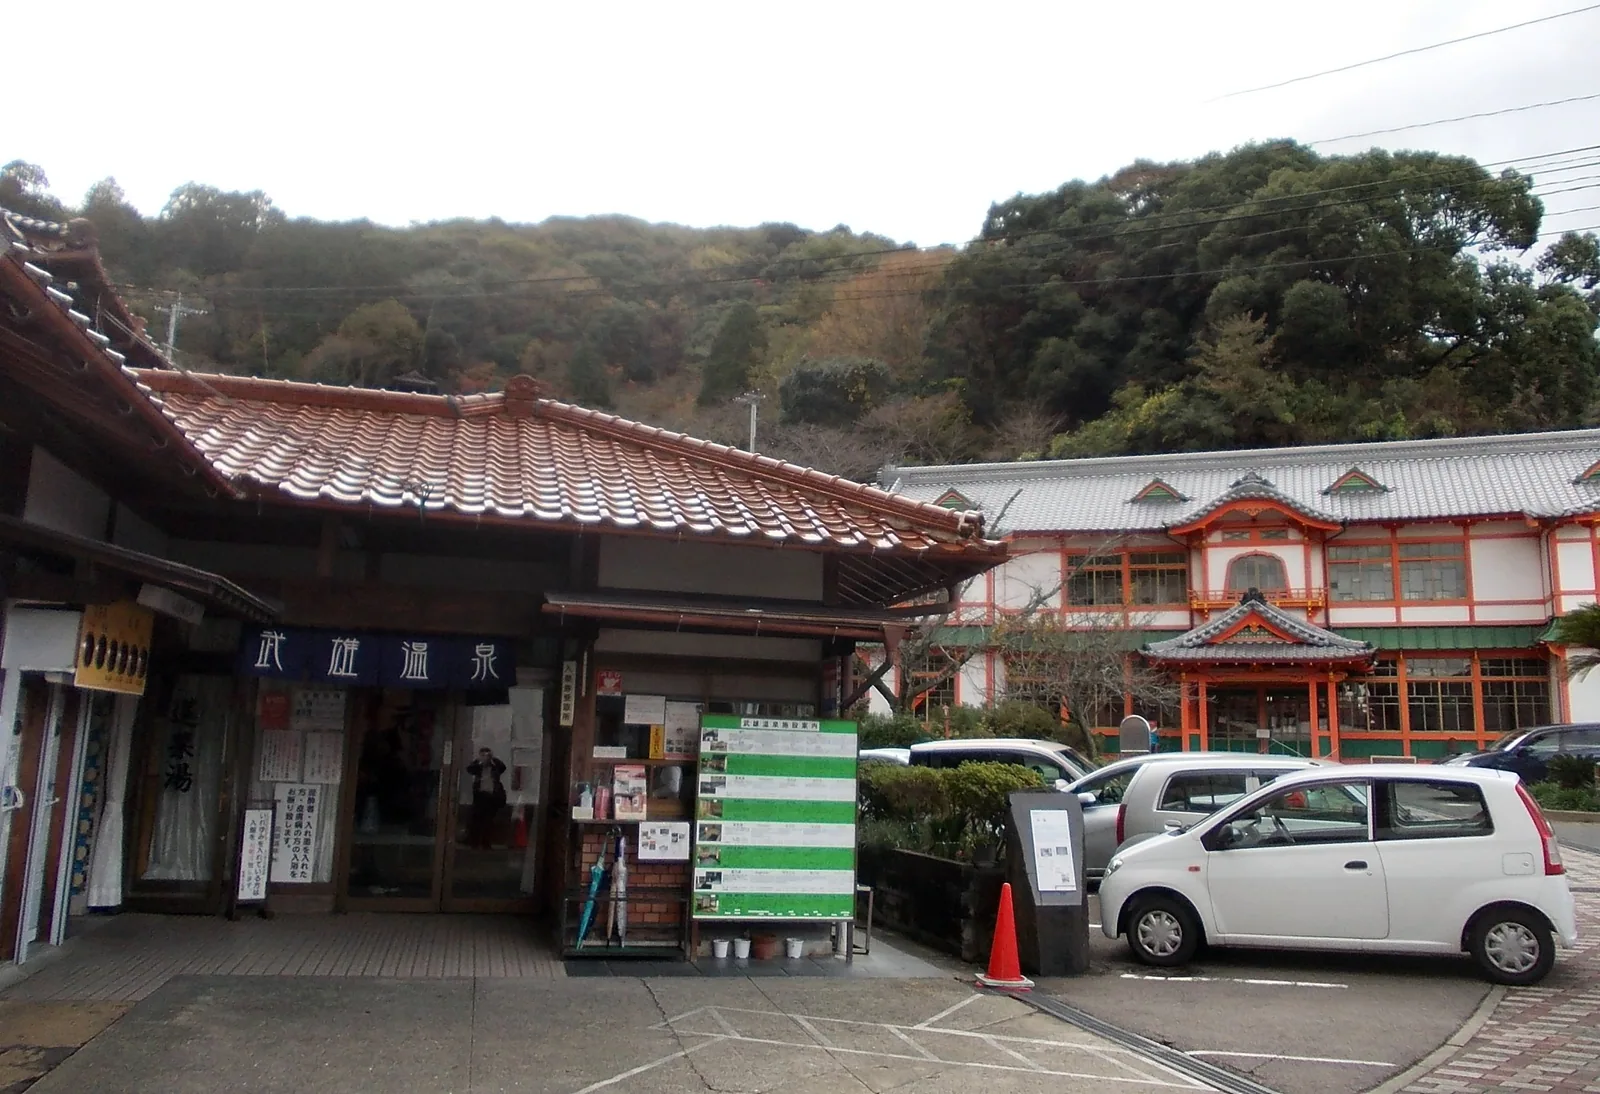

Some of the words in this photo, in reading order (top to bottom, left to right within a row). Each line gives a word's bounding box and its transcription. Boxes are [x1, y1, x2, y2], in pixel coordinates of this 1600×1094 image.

[254, 630, 499, 680] 武雄温泉
[743, 720, 818, 730] 武雄温泉施設案内
